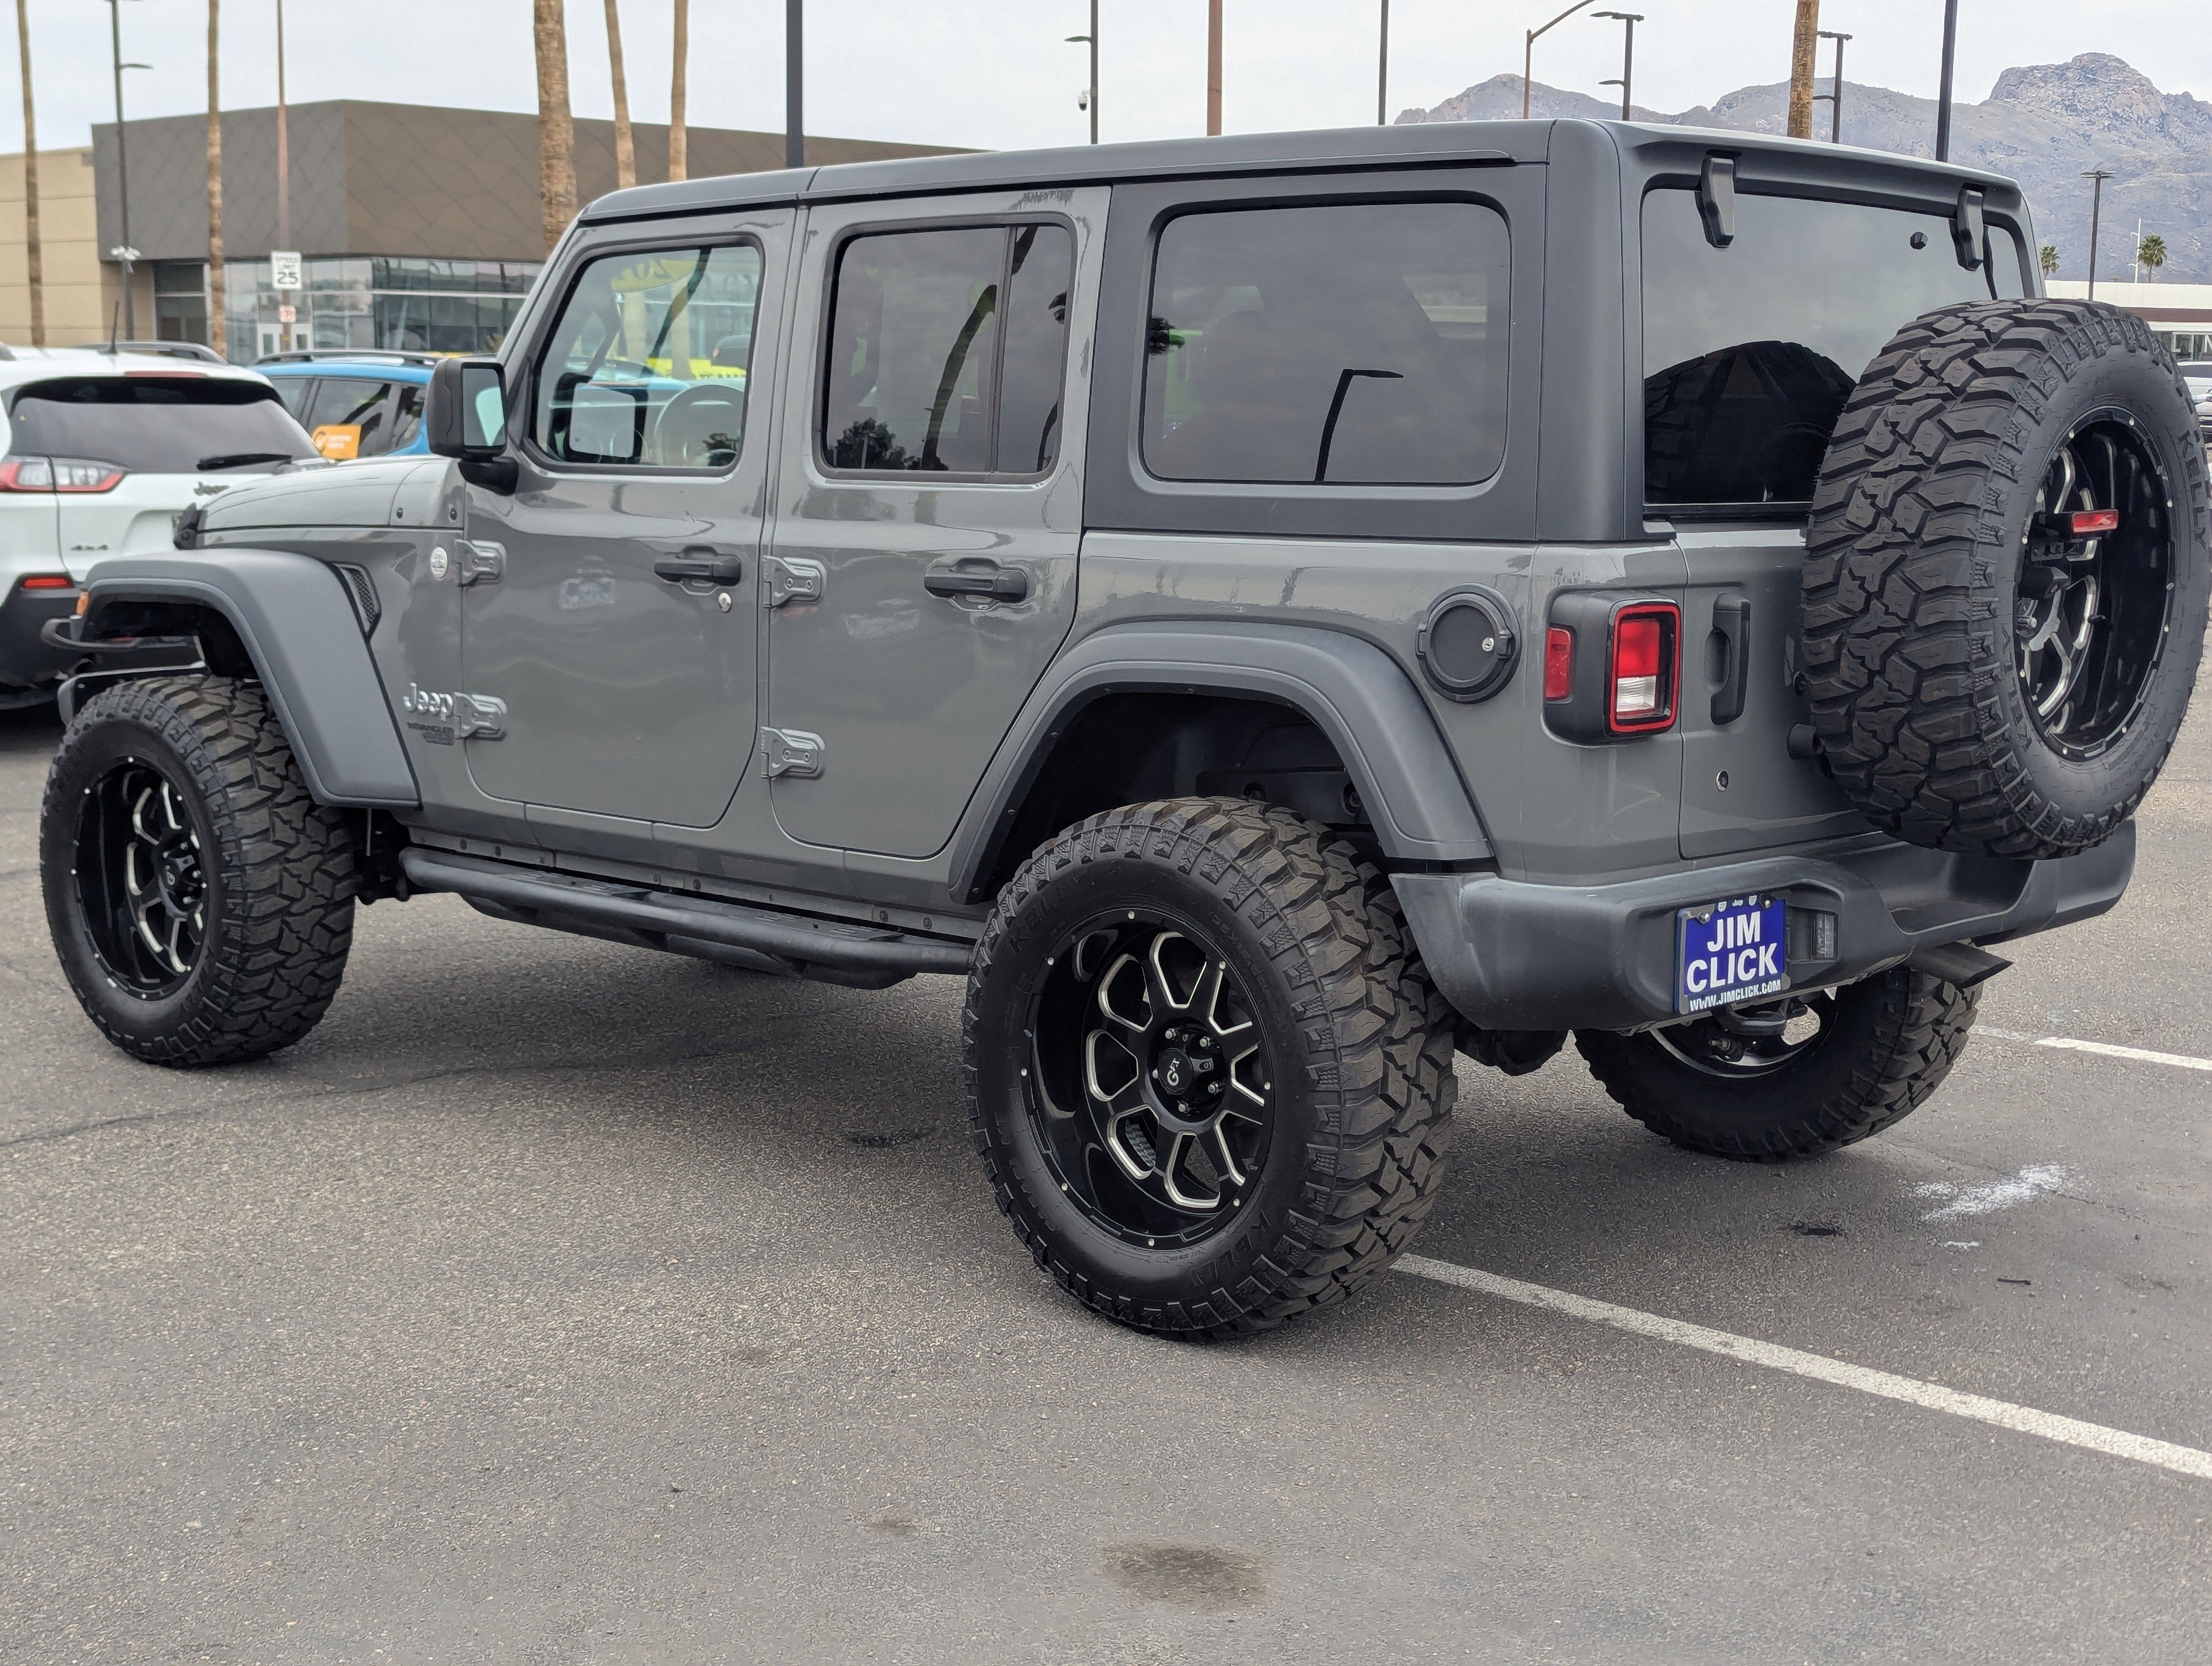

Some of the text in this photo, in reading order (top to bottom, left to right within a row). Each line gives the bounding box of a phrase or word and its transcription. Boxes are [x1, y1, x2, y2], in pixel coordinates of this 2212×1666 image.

[276, 272, 298, 285] 25
[2177, 430, 2207, 551] KELLY
[403, 682, 453, 722] Jeep
[1707, 911, 1761, 952] JIM
[1687, 942, 1778, 993] CLICK
[1689, 979, 1782, 1012] WWW.JIMCLICK.COM
